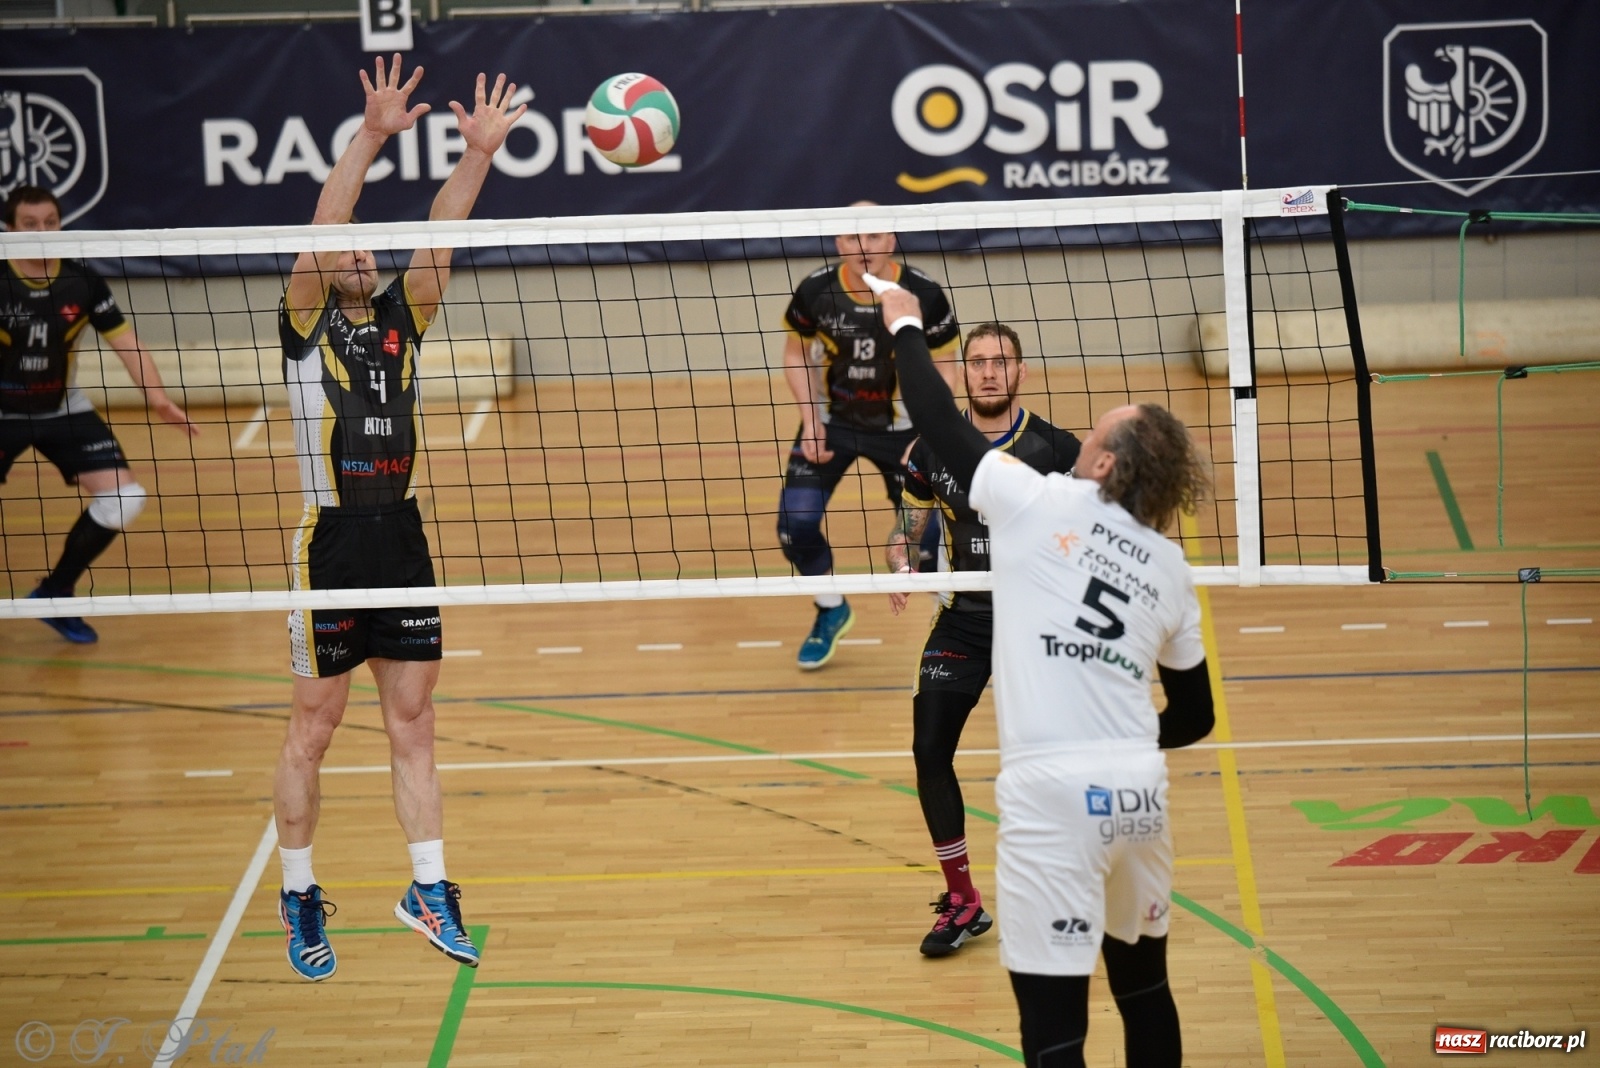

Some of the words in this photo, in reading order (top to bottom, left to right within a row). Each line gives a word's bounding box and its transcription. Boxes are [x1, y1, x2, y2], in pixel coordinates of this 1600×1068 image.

[369, 0, 405, 34] B
[891, 60, 1169, 157] OSiR
[1003, 152, 1169, 188] RACIBÓRZ
[27, 322, 48, 348] 14
[853, 338, 876, 360] 13
[369, 370, 387, 404] 4
[364, 416, 392, 436] ENTER
[971, 537, 990, 554] ENT
[1084, 546, 1121, 575] ZOO
[1091, 523, 1151, 565] PYCIU
[1075, 576, 1130, 641] 5
[1116, 786, 1162, 813] DK
[1099, 810, 1163, 845] glass
